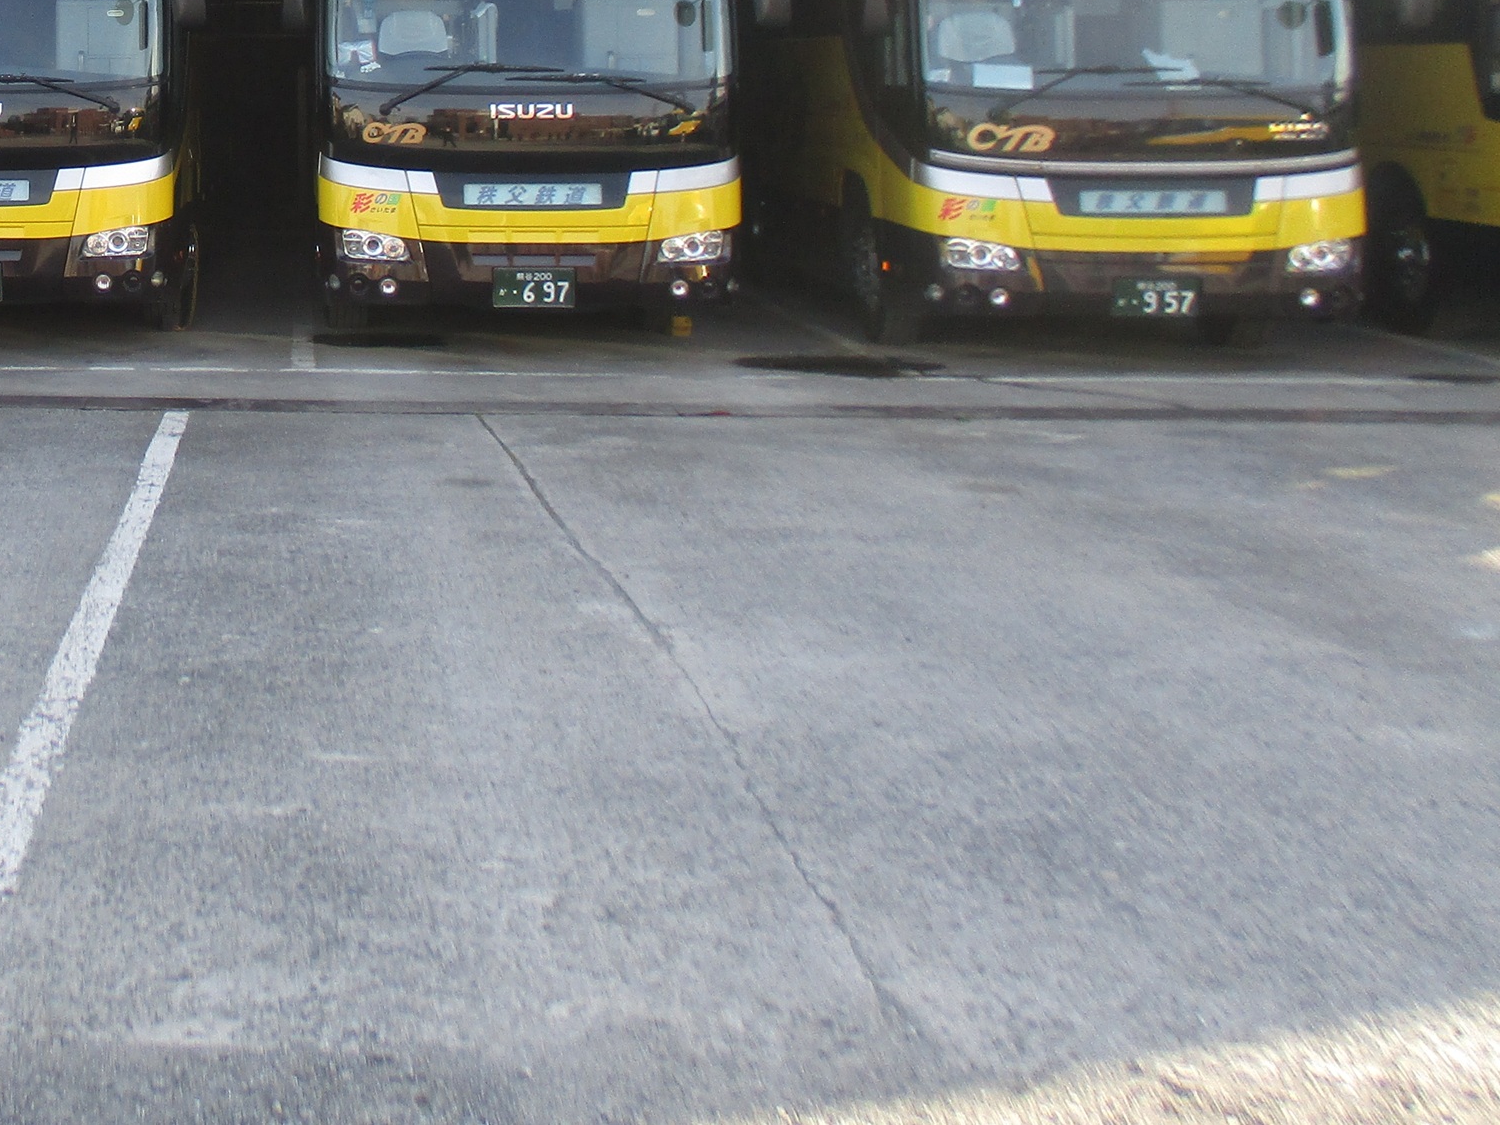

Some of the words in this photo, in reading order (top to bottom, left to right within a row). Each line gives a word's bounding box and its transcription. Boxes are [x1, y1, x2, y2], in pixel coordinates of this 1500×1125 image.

[490, 103, 573, 119] ISUZU
[967, 123, 1055, 153] CTB
[476, 186, 588, 205] 秩父鉄道
